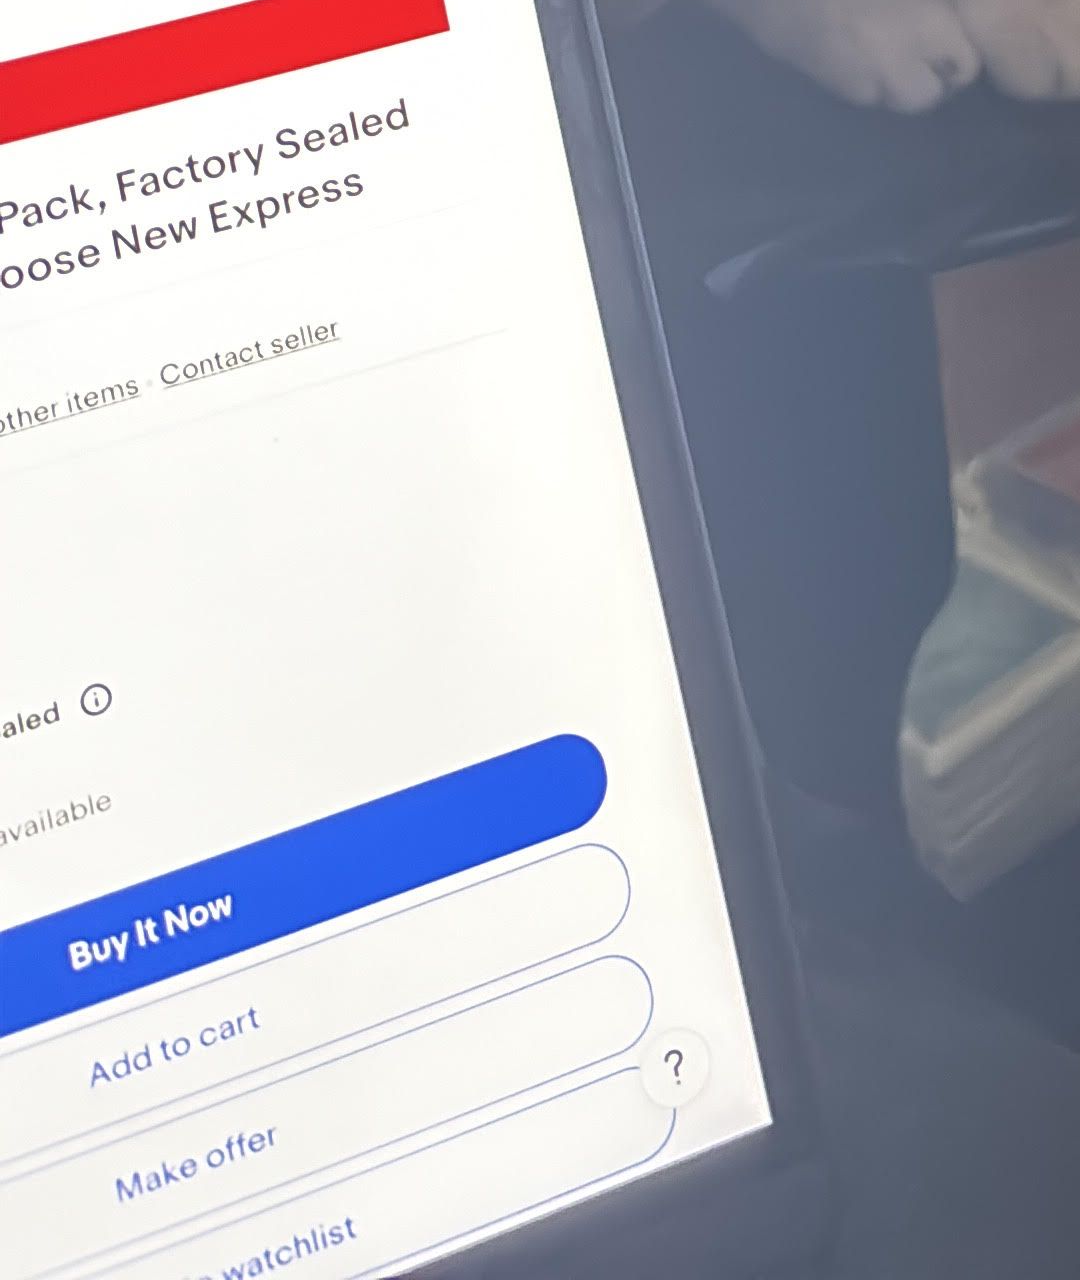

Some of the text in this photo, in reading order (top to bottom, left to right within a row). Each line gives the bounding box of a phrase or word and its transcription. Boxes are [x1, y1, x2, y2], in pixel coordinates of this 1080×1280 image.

[0, 98, 409, 234] Pack, Factory Sealed
[112, 217, 196, 259] New
[209, 174, 363, 233] Express
[66, 379, 139, 413] items
[160, 341, 263, 385] Contact
[270, 322, 339, 354] seller
[69, 895, 231, 970] Buy It Now
[91, 1008, 259, 1086] Add to cart
[116, 1128, 275, 1201] Make offer
[223, 1218, 356, 1280] watchlist
